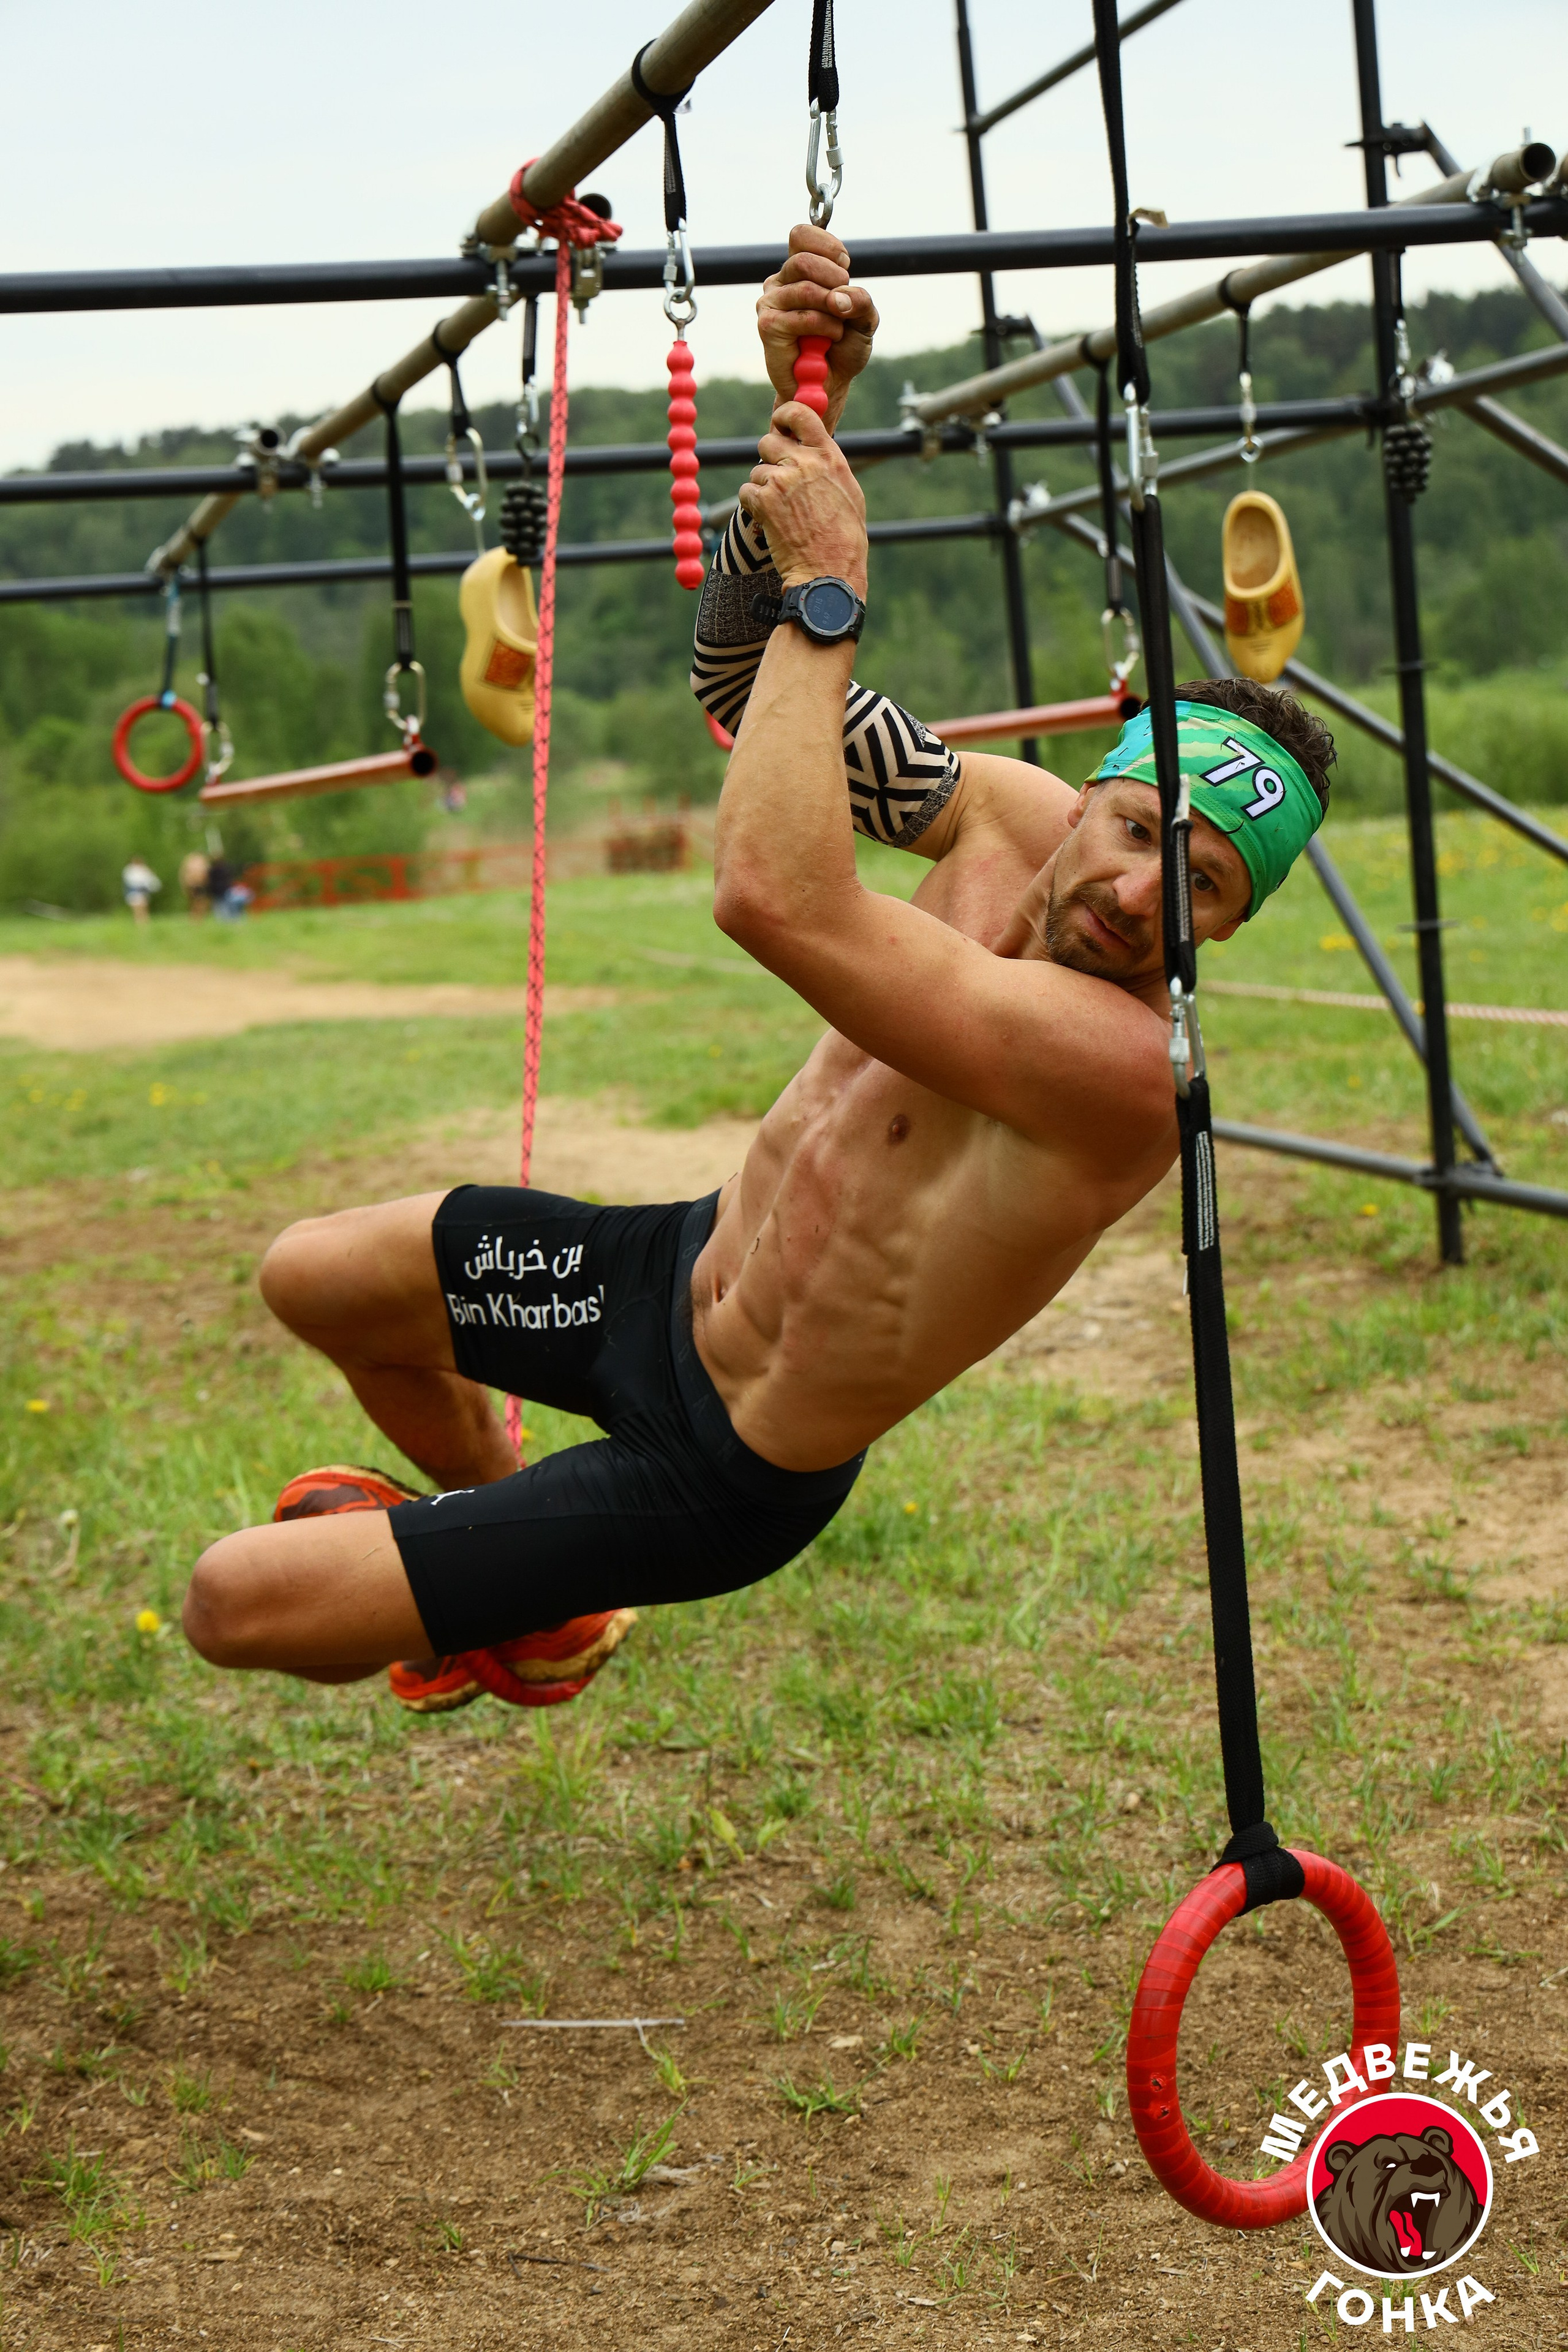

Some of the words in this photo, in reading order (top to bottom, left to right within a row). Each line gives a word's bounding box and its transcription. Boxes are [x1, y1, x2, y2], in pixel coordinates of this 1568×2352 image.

[1199, 736, 1286, 821] 79
[464, 1234, 548, 1280] خرباش
[552, 1244, 584, 1279] بن
[446, 1292, 488, 1325] Bin
